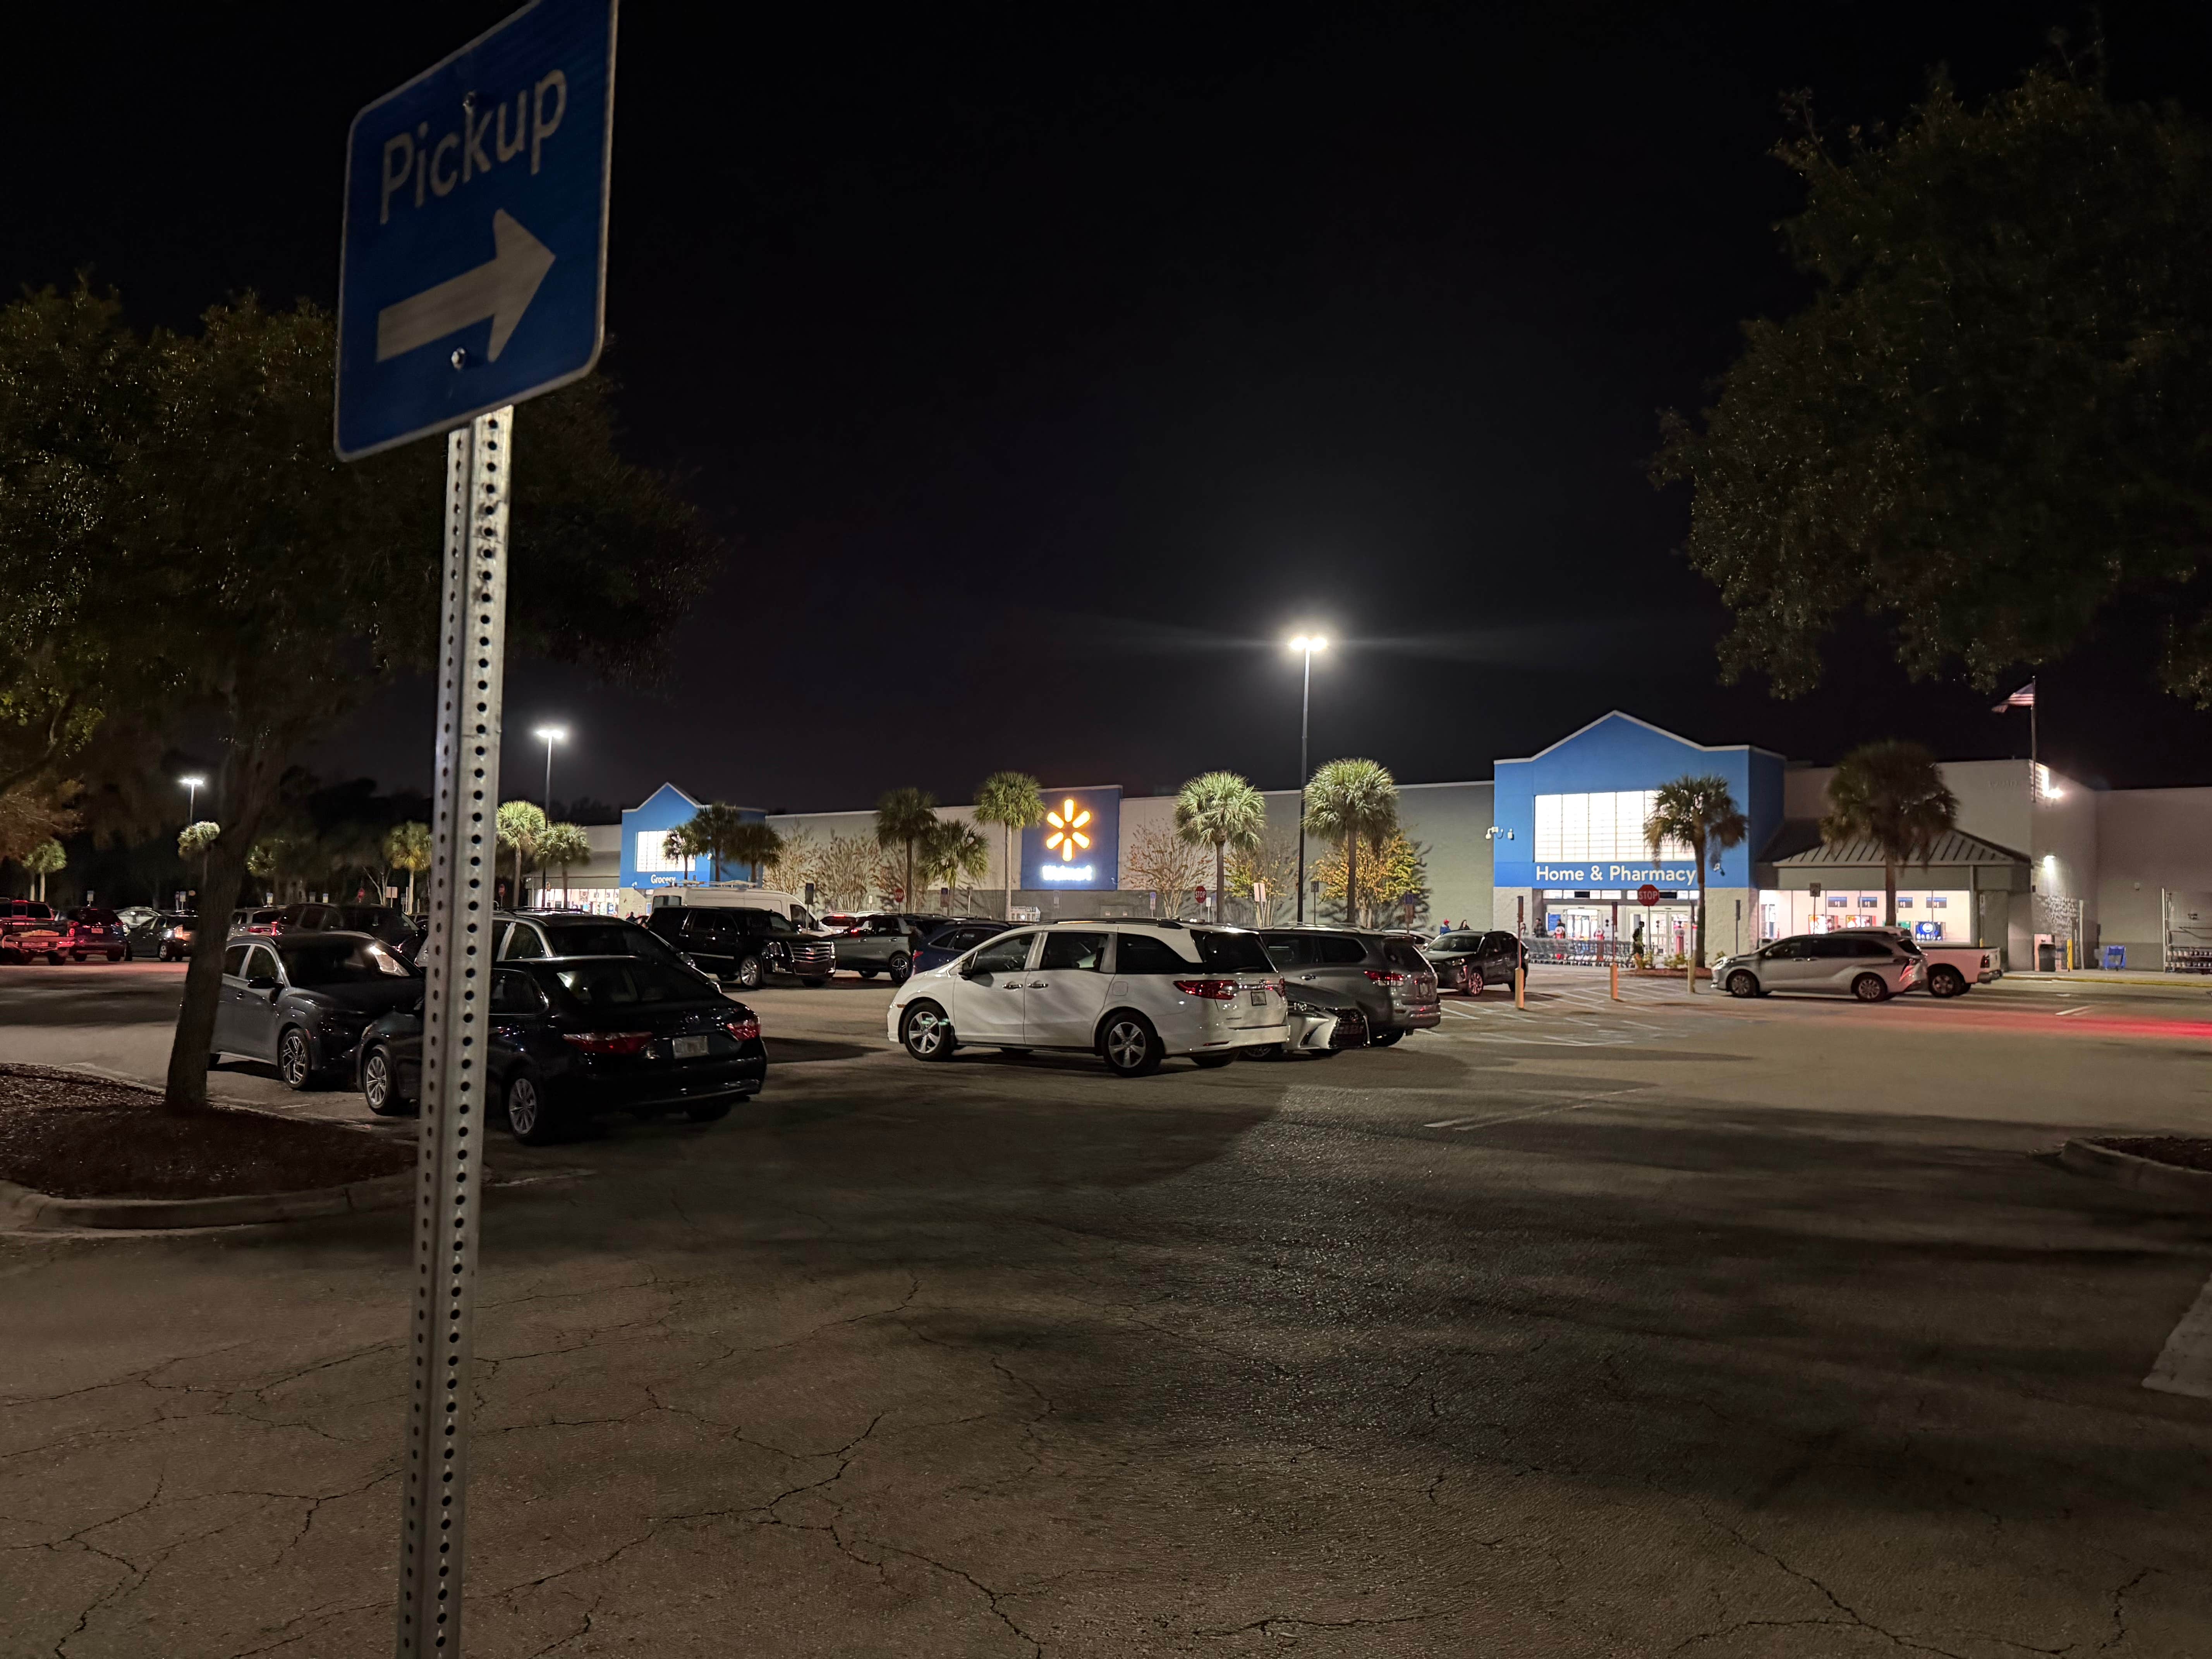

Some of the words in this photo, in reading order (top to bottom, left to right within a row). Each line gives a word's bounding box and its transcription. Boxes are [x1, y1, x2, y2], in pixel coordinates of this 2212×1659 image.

[380, 68, 567, 225] Pickup
[650, 874, 676, 886] Grocery
[1536, 865, 1585, 881] Home
[1590, 865, 1603, 881] &
[1609, 865, 1697, 886] Pharmacy
[1638, 891, 1657, 900] STOP
